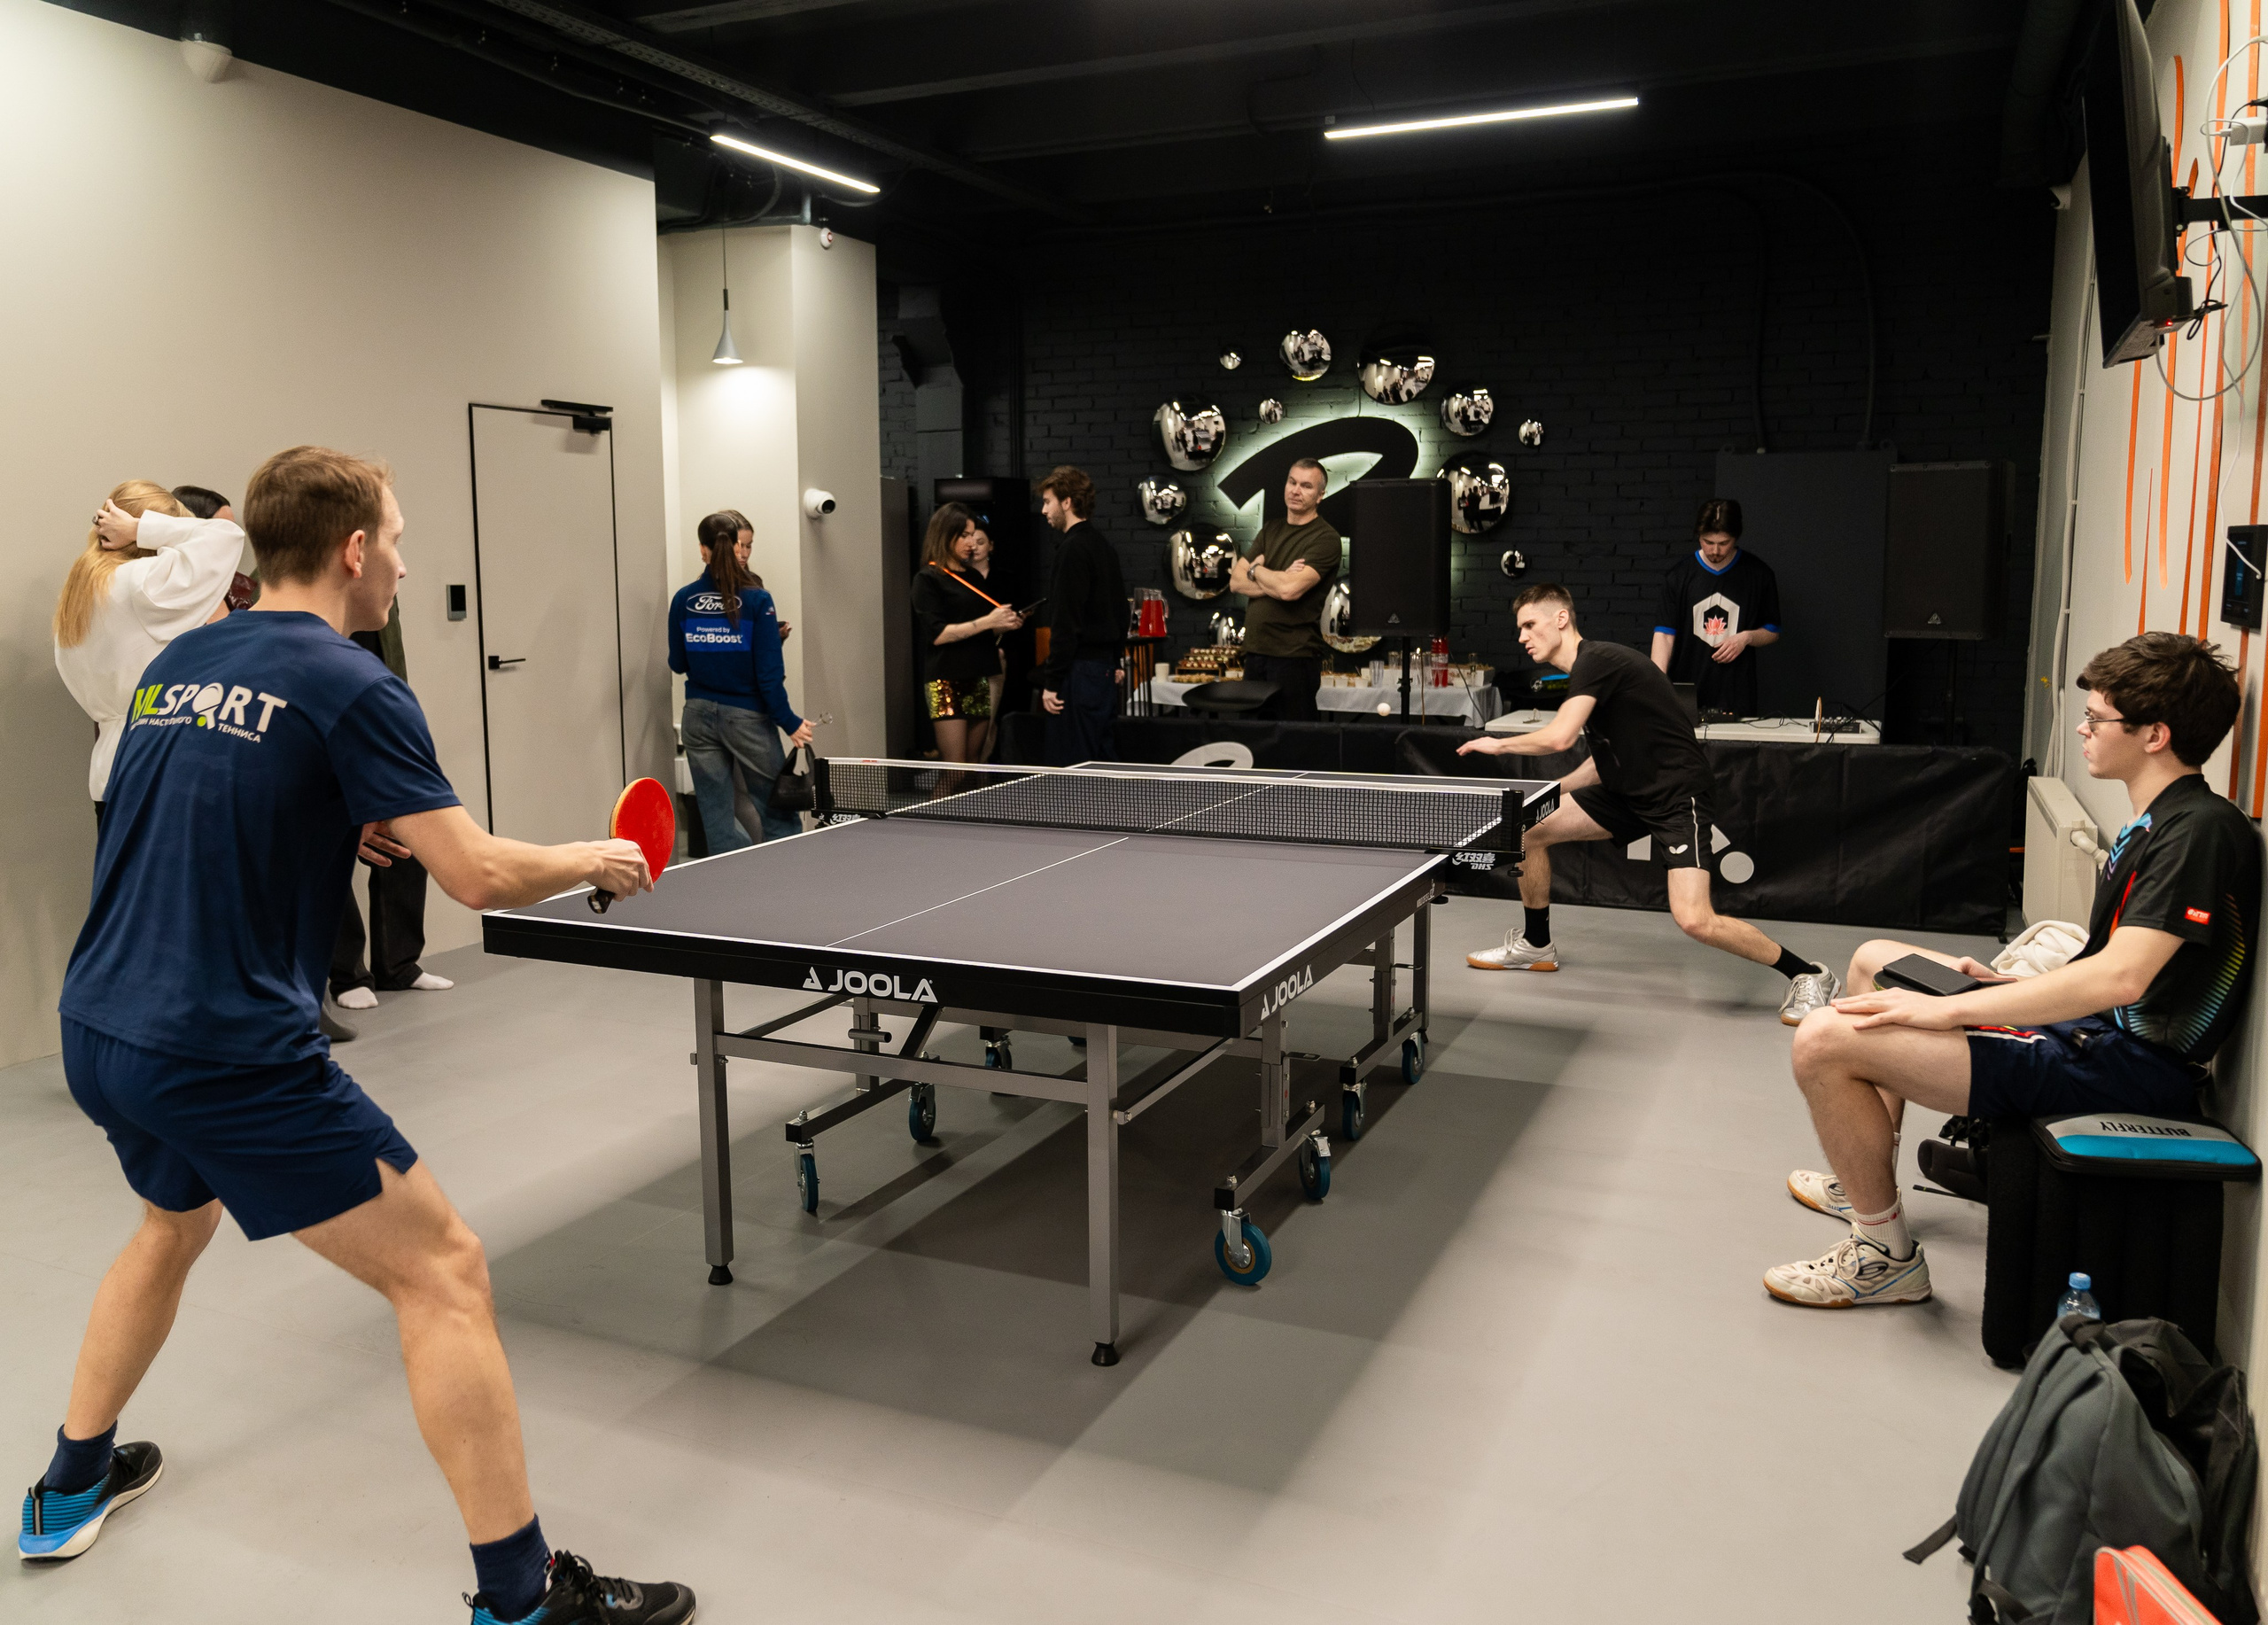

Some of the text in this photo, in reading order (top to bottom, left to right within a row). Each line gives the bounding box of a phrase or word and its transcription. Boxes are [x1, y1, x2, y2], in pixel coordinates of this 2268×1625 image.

[685, 633, 742, 644] EcoBoost
[132, 682, 288, 733] MLSPORT
[217, 722, 261, 743] ТЕННИСА
[1540, 797, 1555, 820] JOOLA
[1471, 862, 1495, 871] DHS
[827, 968, 938, 1003] JOOLA
[1270, 964, 1314, 1014] JOOLA
[2100, 1121, 2192, 1137] BUTTERFLY
